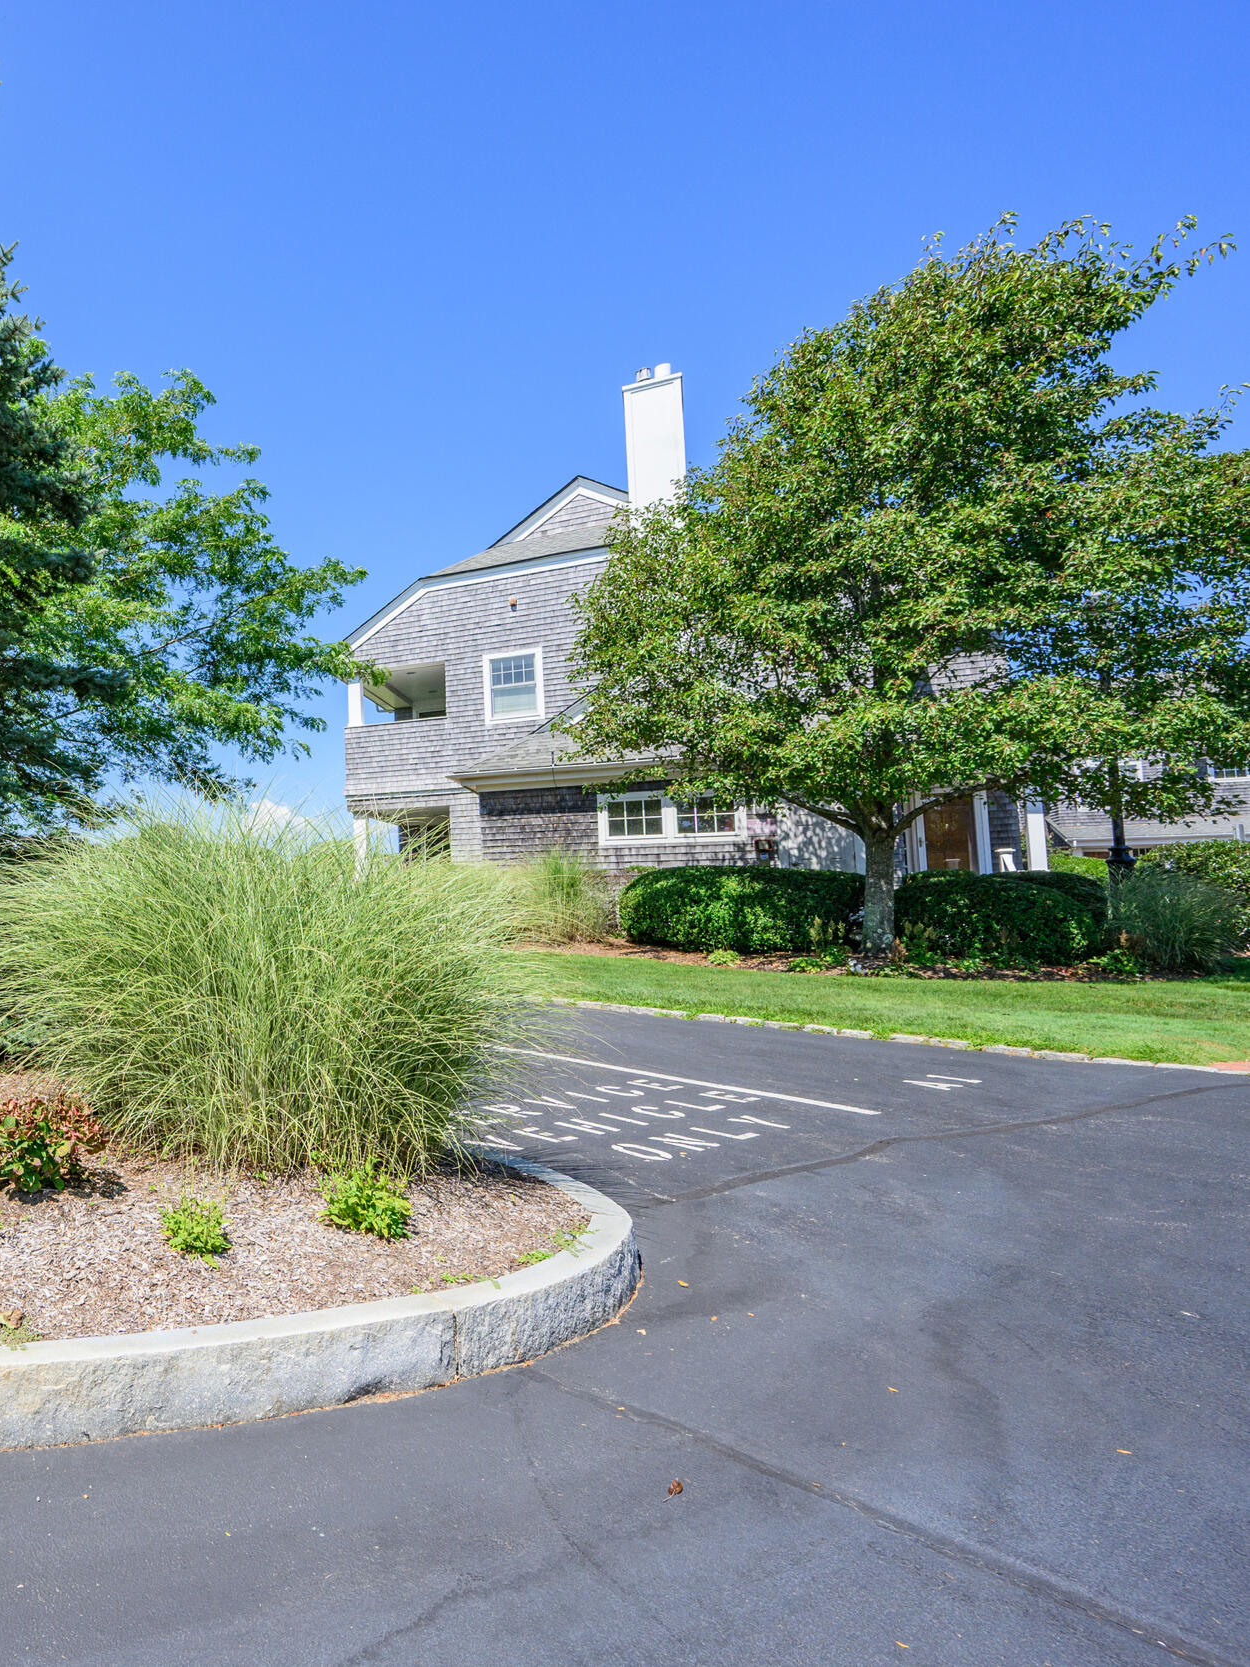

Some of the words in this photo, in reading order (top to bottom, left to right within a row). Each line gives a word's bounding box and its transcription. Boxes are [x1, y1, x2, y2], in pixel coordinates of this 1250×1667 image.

[445, 1078, 685, 1135] ERVICE
[463, 1090, 761, 1151] VEHICLE
[611, 1115, 791, 1161] ONLY
